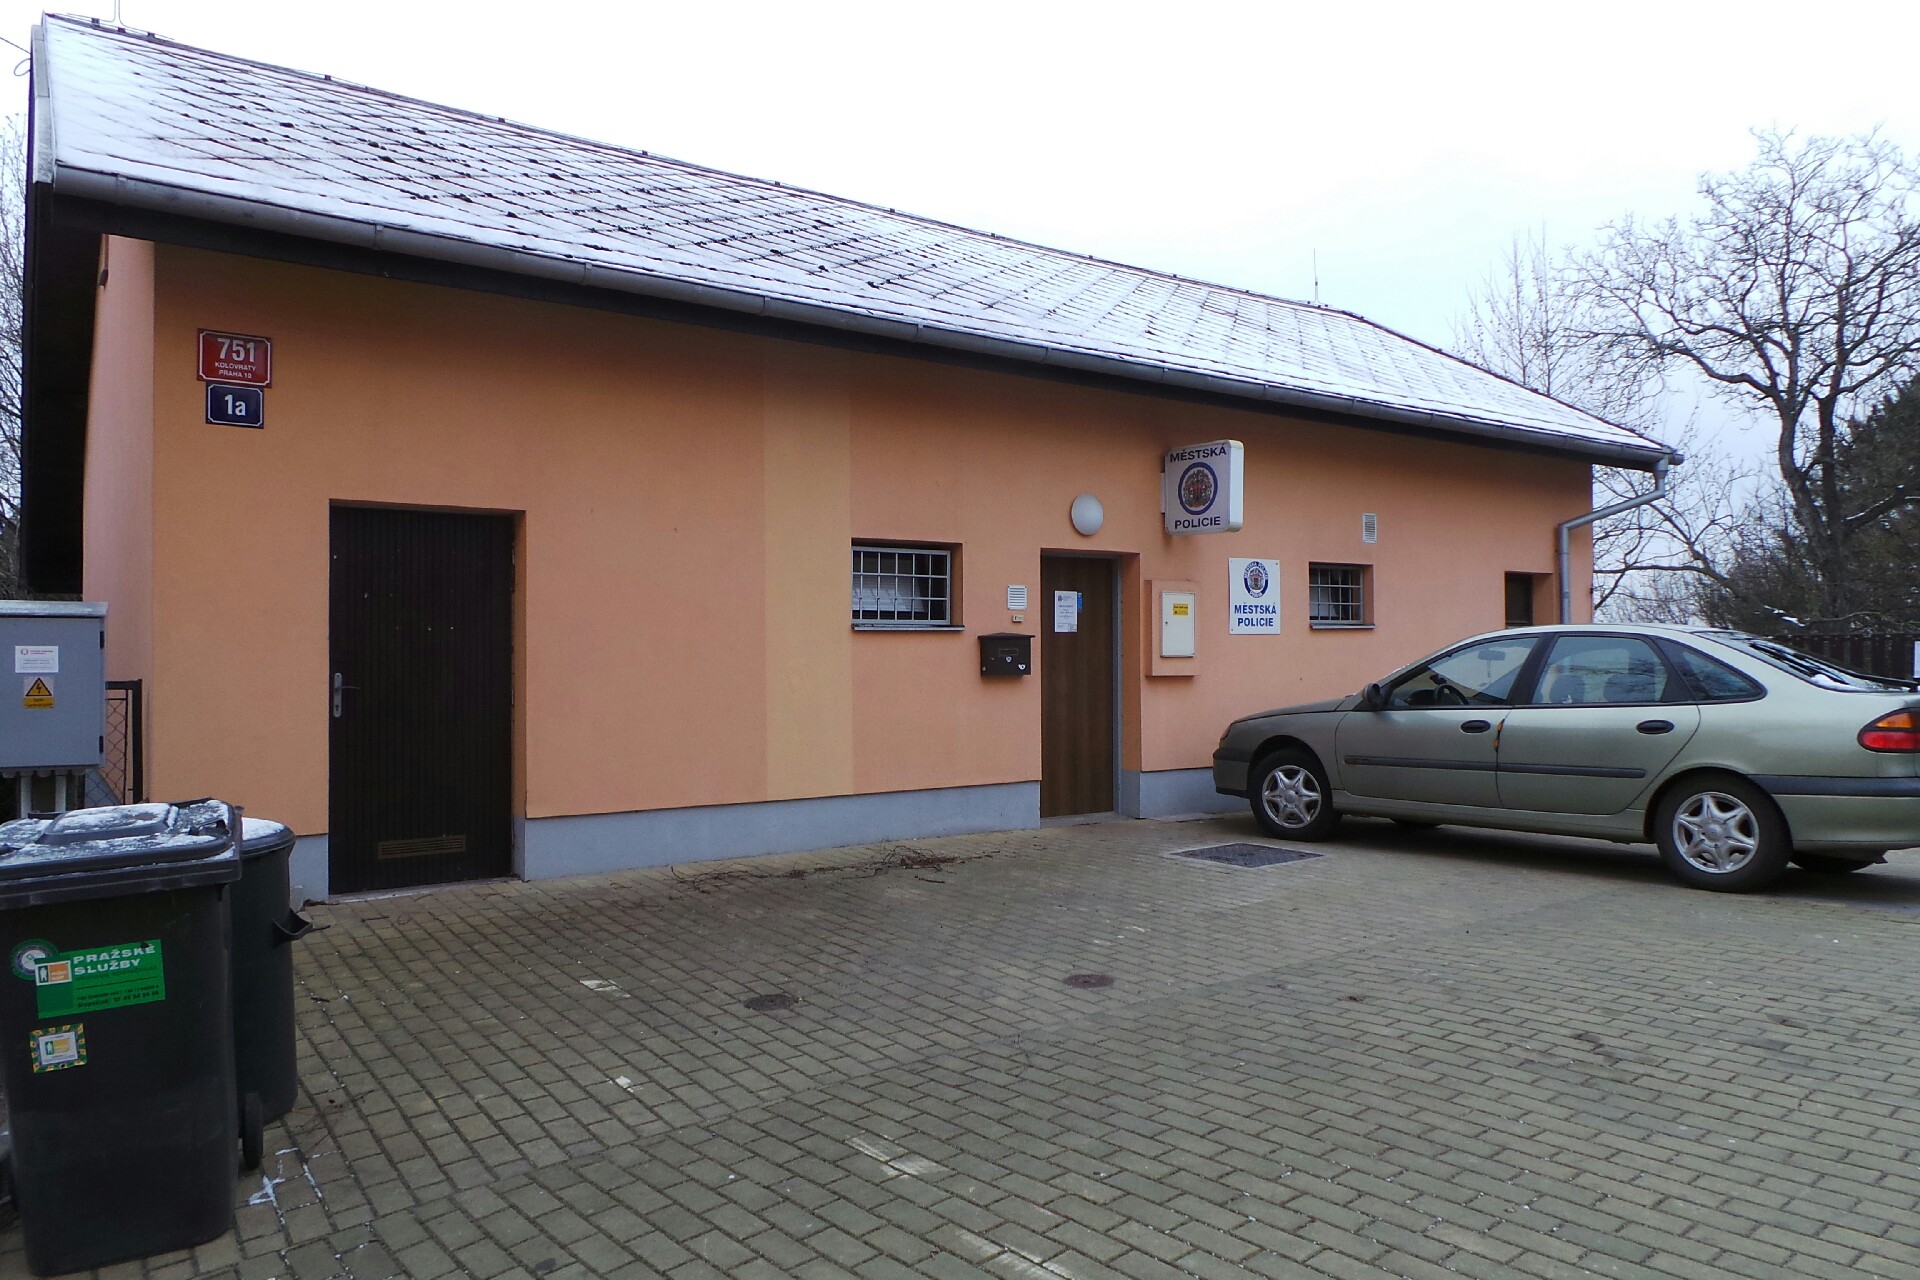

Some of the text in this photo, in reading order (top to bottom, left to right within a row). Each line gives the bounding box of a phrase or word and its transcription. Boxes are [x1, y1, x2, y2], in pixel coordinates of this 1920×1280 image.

[217, 338, 255, 362] 751
[215, 362, 256, 371] KOLOVRATY
[224, 394, 246, 416] 1a
[1169, 444, 1227, 463] MĚSTSKÁ
[1174, 516, 1221, 530] POLICIE
[1234, 602, 1277, 615] MĚSTSKÁ
[1237, 617, 1274, 627] POLICIE
[74, 959, 141, 975] SLUŽBY
